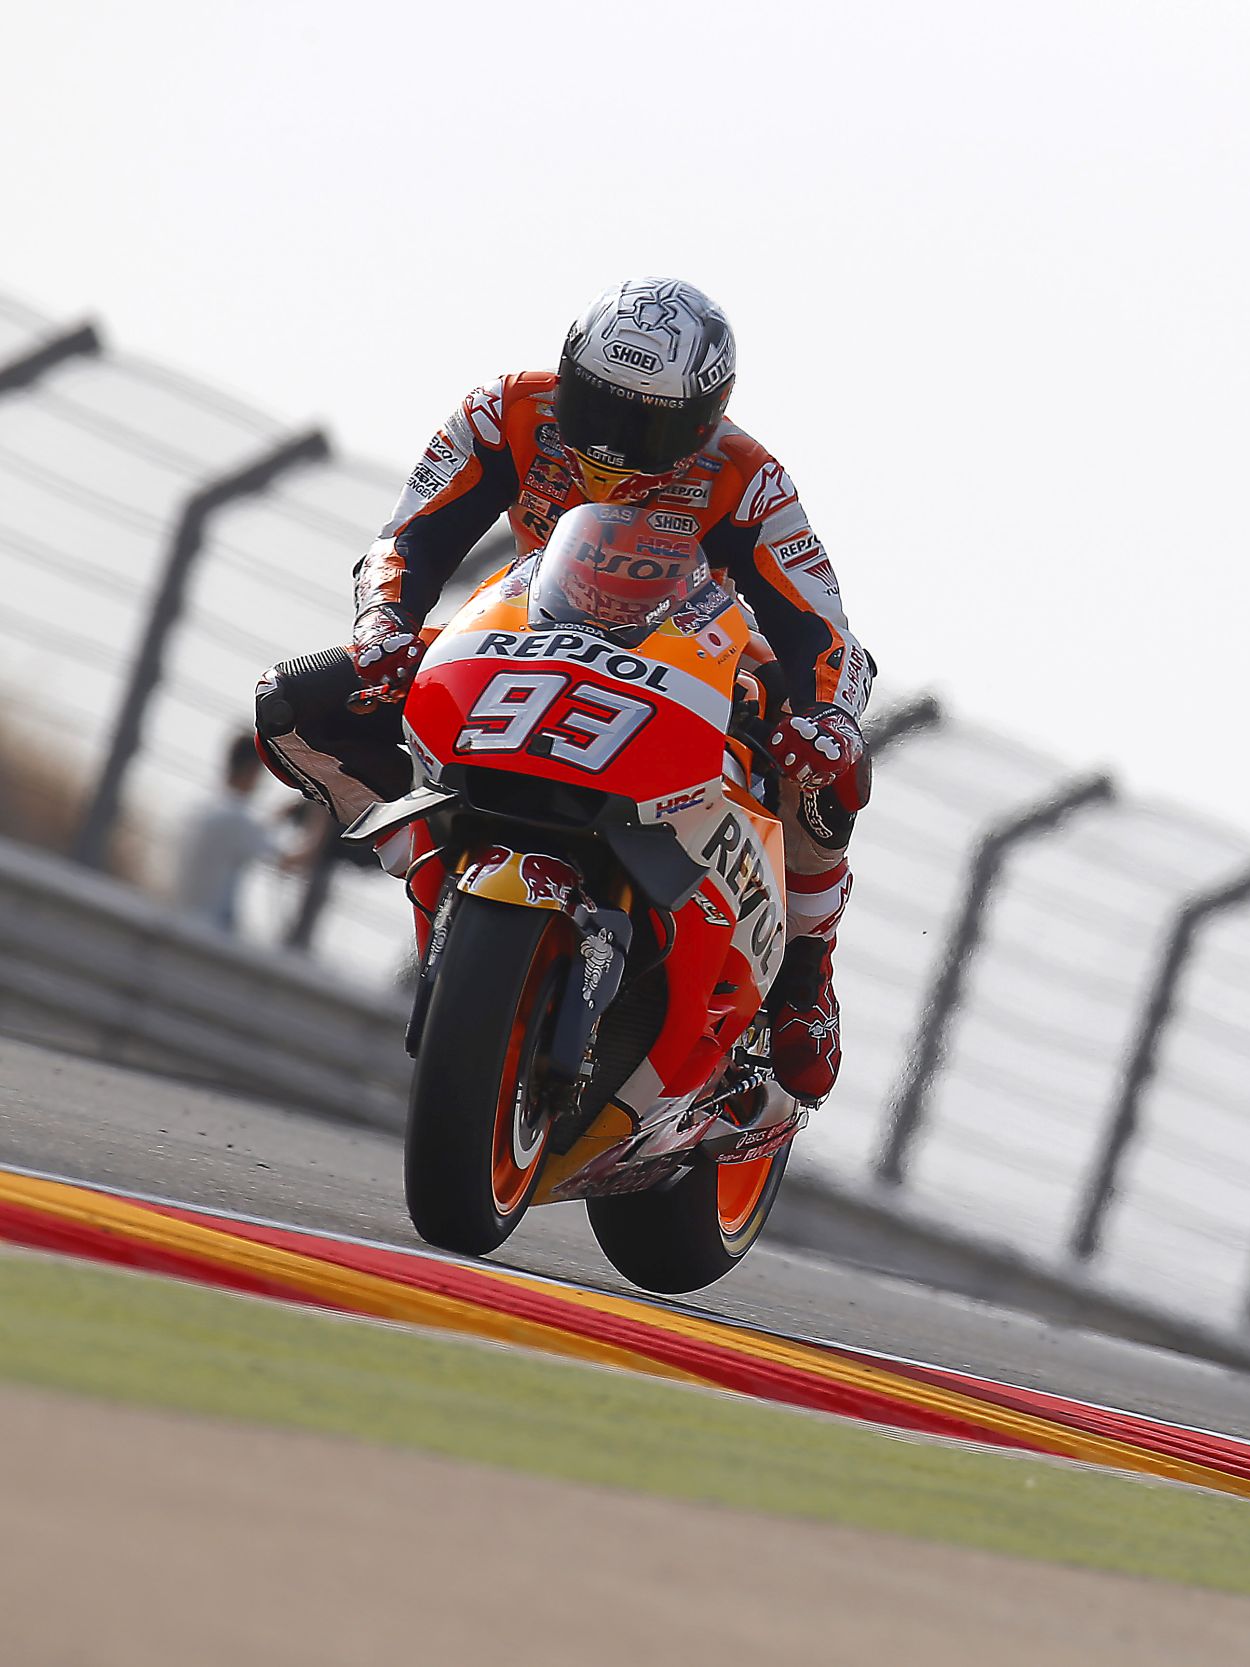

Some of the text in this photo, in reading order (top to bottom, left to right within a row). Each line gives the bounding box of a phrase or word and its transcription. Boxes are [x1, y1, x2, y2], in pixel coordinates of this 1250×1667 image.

[609, 344, 657, 371] SHOEI
[574, 367, 685, 409] GIVES YOU WINGS
[586, 448, 625, 467] LOTUS
[526, 474, 548, 492] Red
[547, 485, 568, 501] Bull
[655, 515, 693, 533] SHOEI
[553, 622, 606, 638] HONDA
[475, 632, 669, 693] REPSOL
[452, 669, 657, 775] 93
[655, 787, 706, 819] HRC
